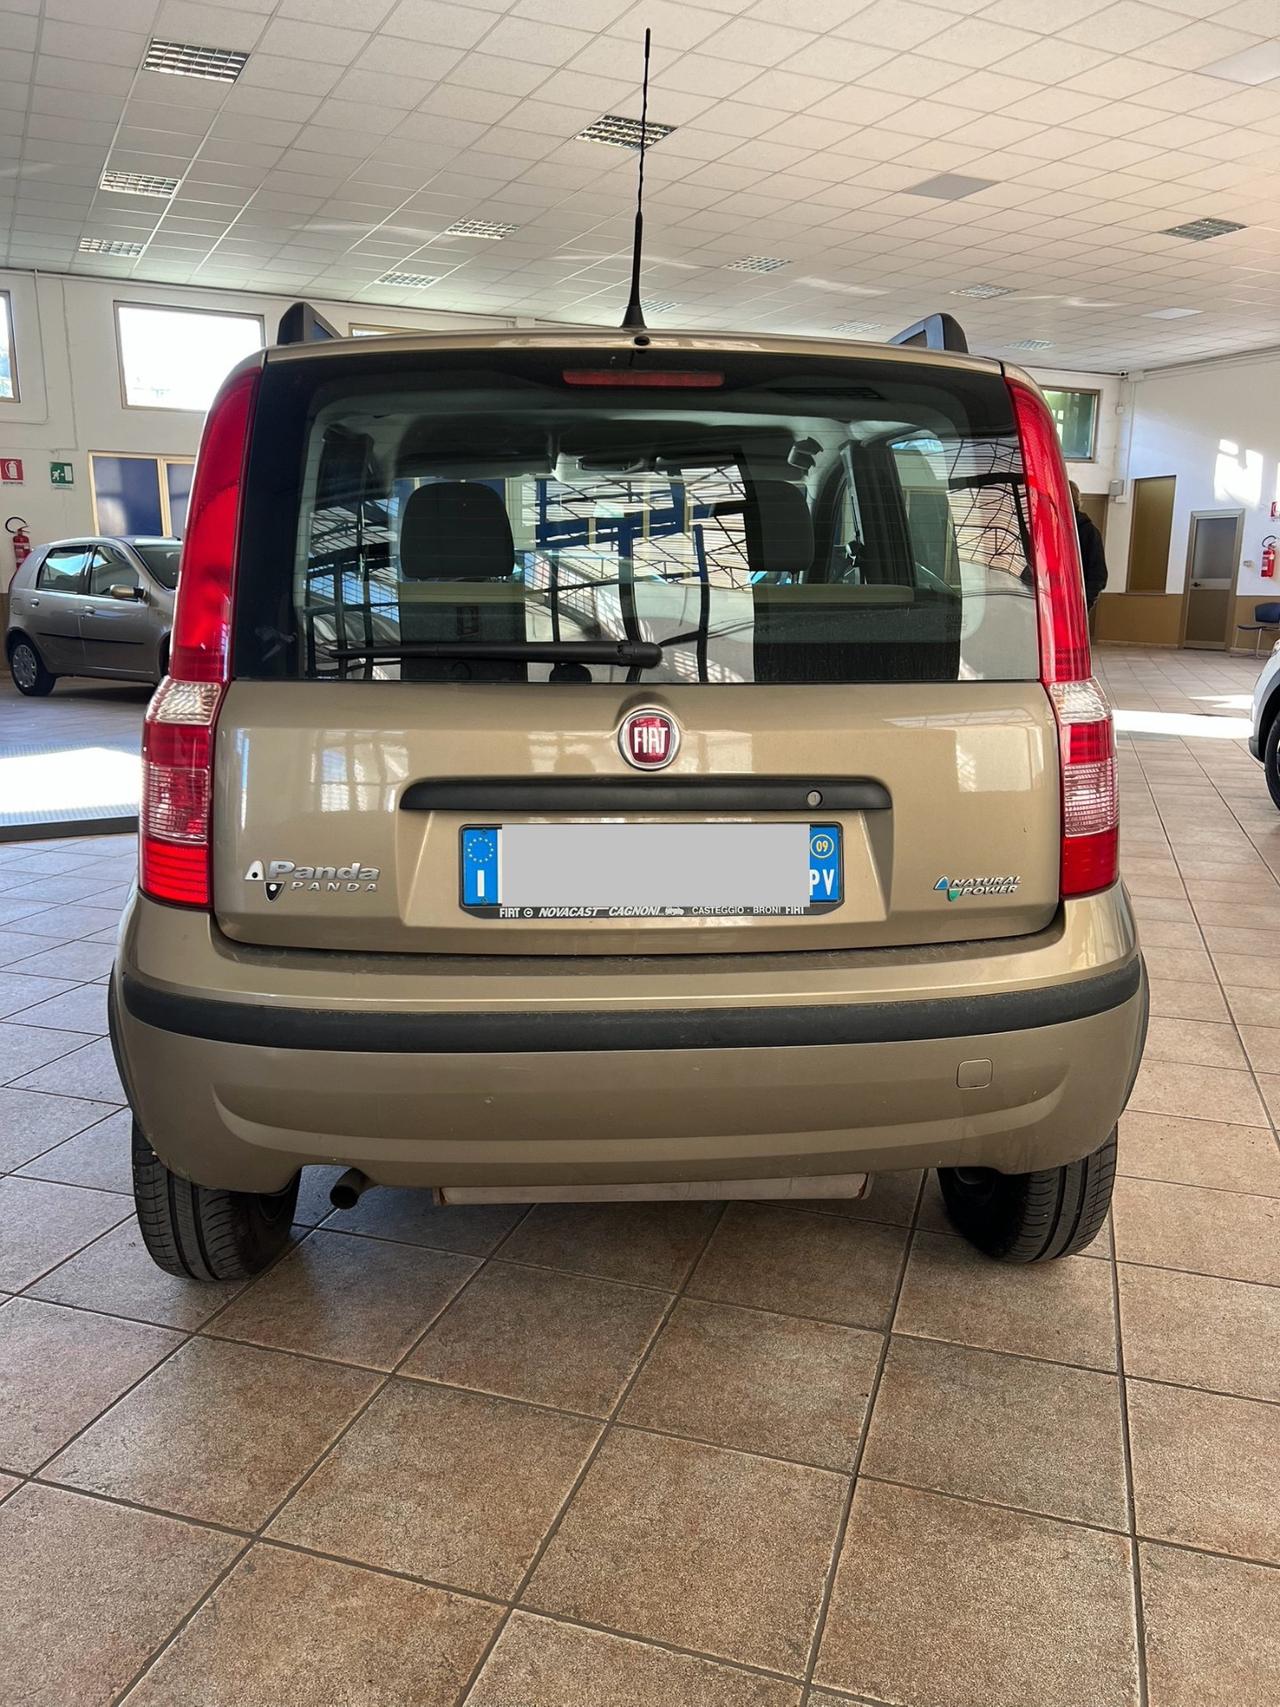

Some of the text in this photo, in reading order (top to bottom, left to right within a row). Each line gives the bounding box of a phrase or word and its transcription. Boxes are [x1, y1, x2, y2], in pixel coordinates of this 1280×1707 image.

[634, 727, 668, 753] FIAT
[816, 840, 828, 852] 09
[269, 860, 380, 880] Panda
[290, 882, 377, 892] PANDA
[477, 870, 485, 896] I
[809, 869, 834, 896] PV
[950, 876, 1022, 888] NATURAL
[960, 885, 1018, 896] POWER
[499, 907, 520, 918] FIAT
[539, 907, 600, 918] NOVACAST
[608, 906, 661, 917] CAGNONI
[691, 906, 745, 915] CASTEGGIO
[753, 906, 781, 914] BRONI
